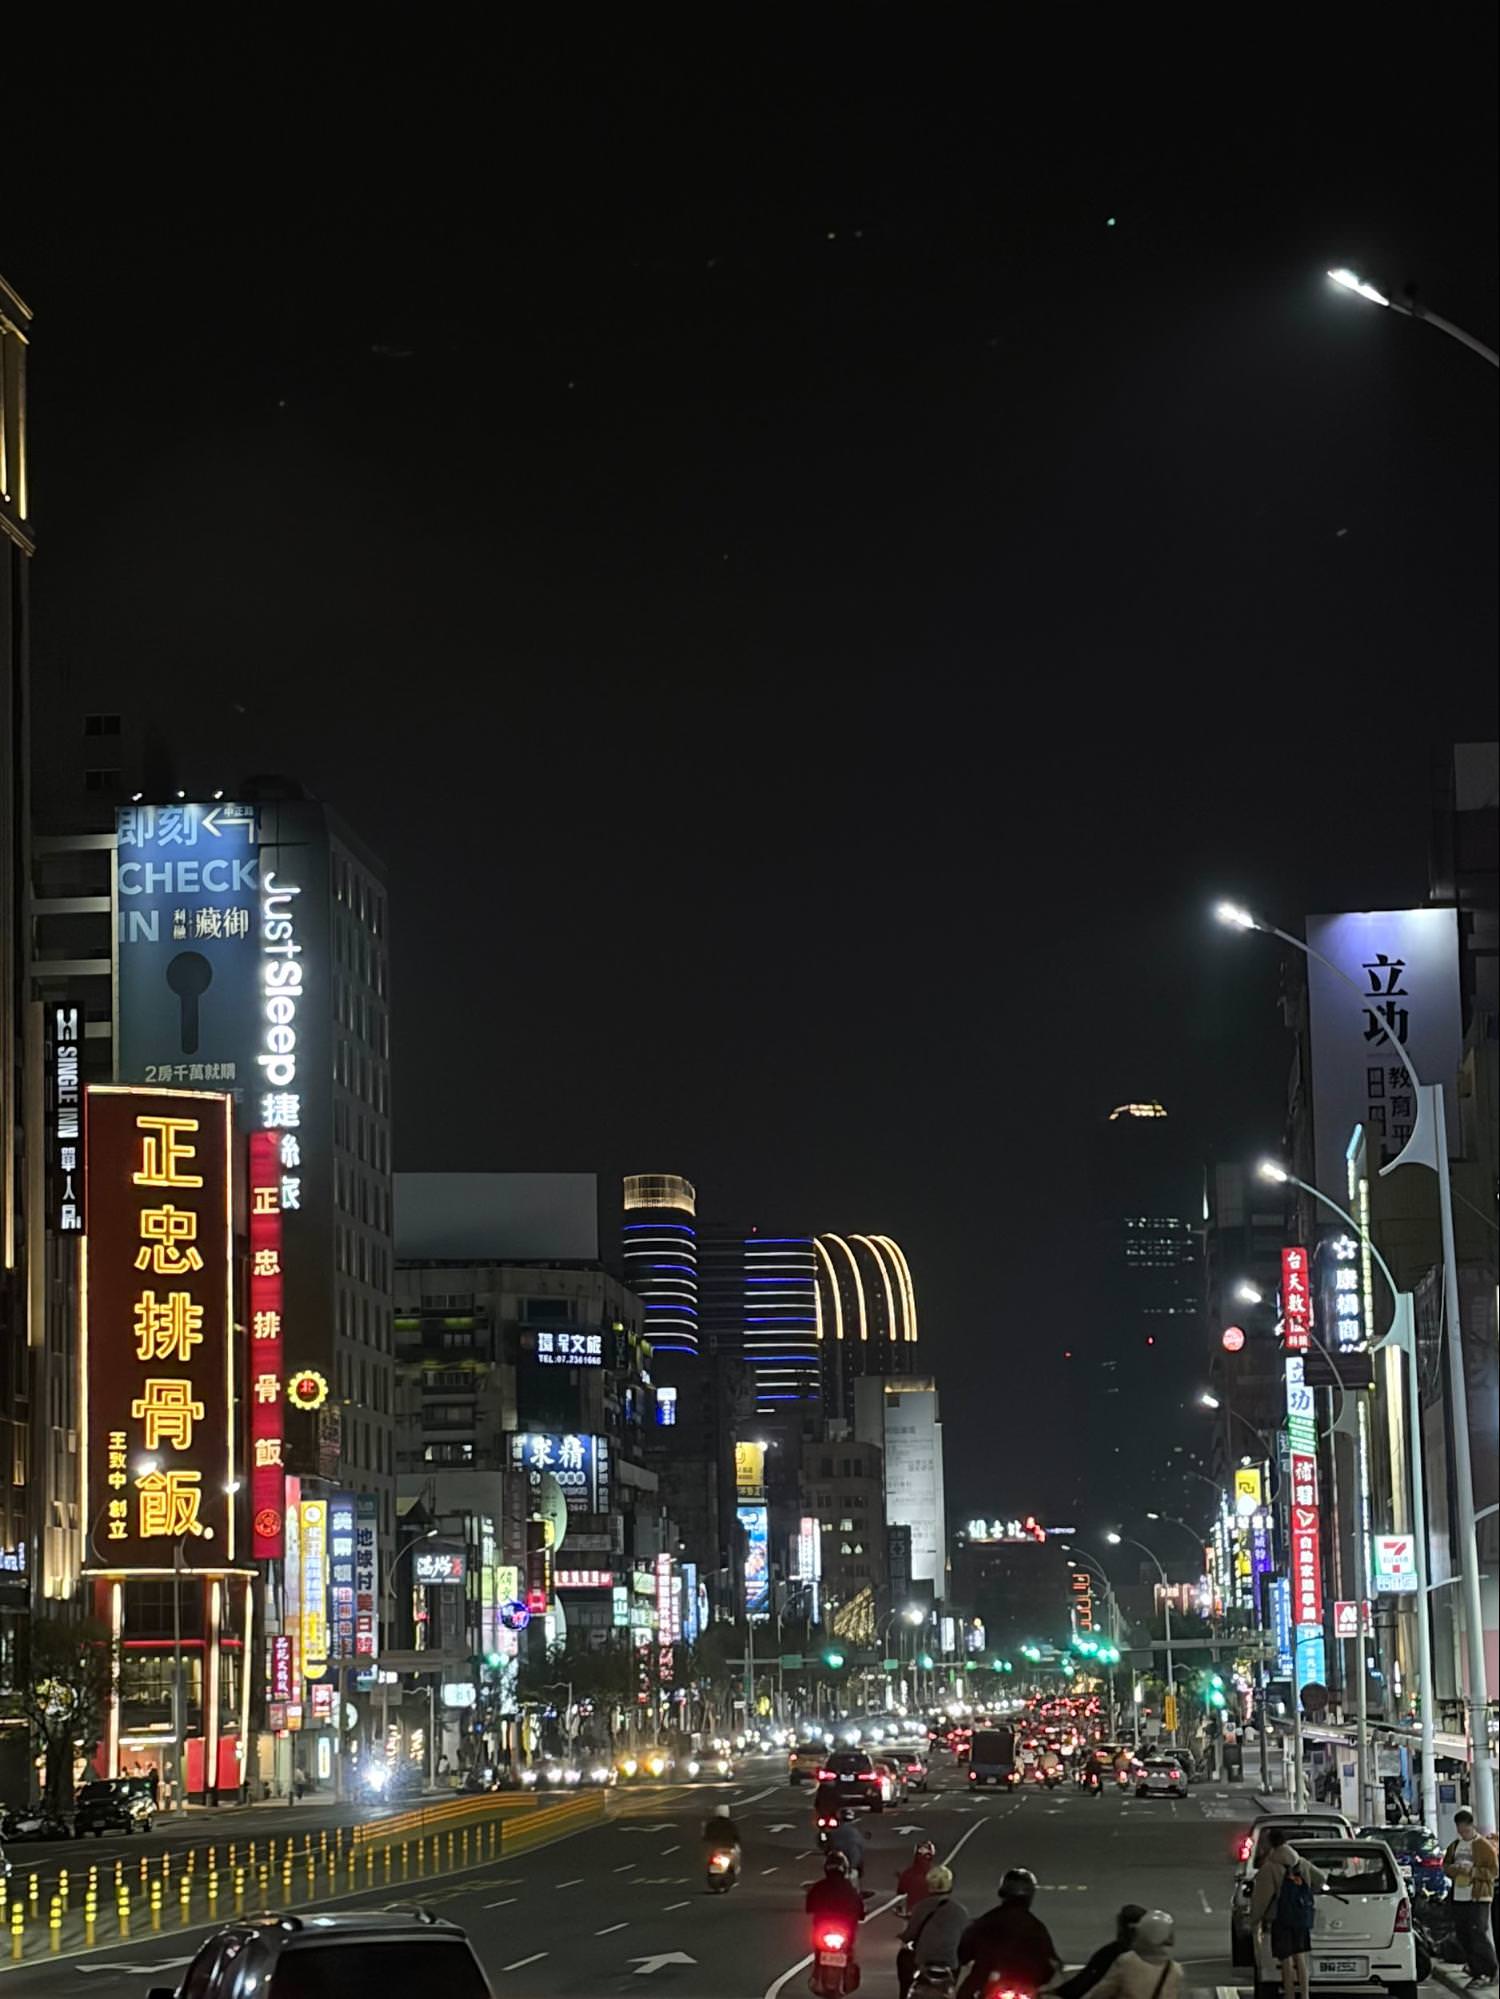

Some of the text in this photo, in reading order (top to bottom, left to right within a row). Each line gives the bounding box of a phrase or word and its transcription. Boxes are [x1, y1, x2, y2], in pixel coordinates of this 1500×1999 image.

[118, 806, 198, 848] 即刻
[118, 859, 259, 895] CHECK
[118, 910, 159, 942] IN
[1361, 953, 1408, 1047] 立功
[57, 1046, 79, 1138] SINGLE INN
[108, 1432, 128, 1540] 王致中 創立
